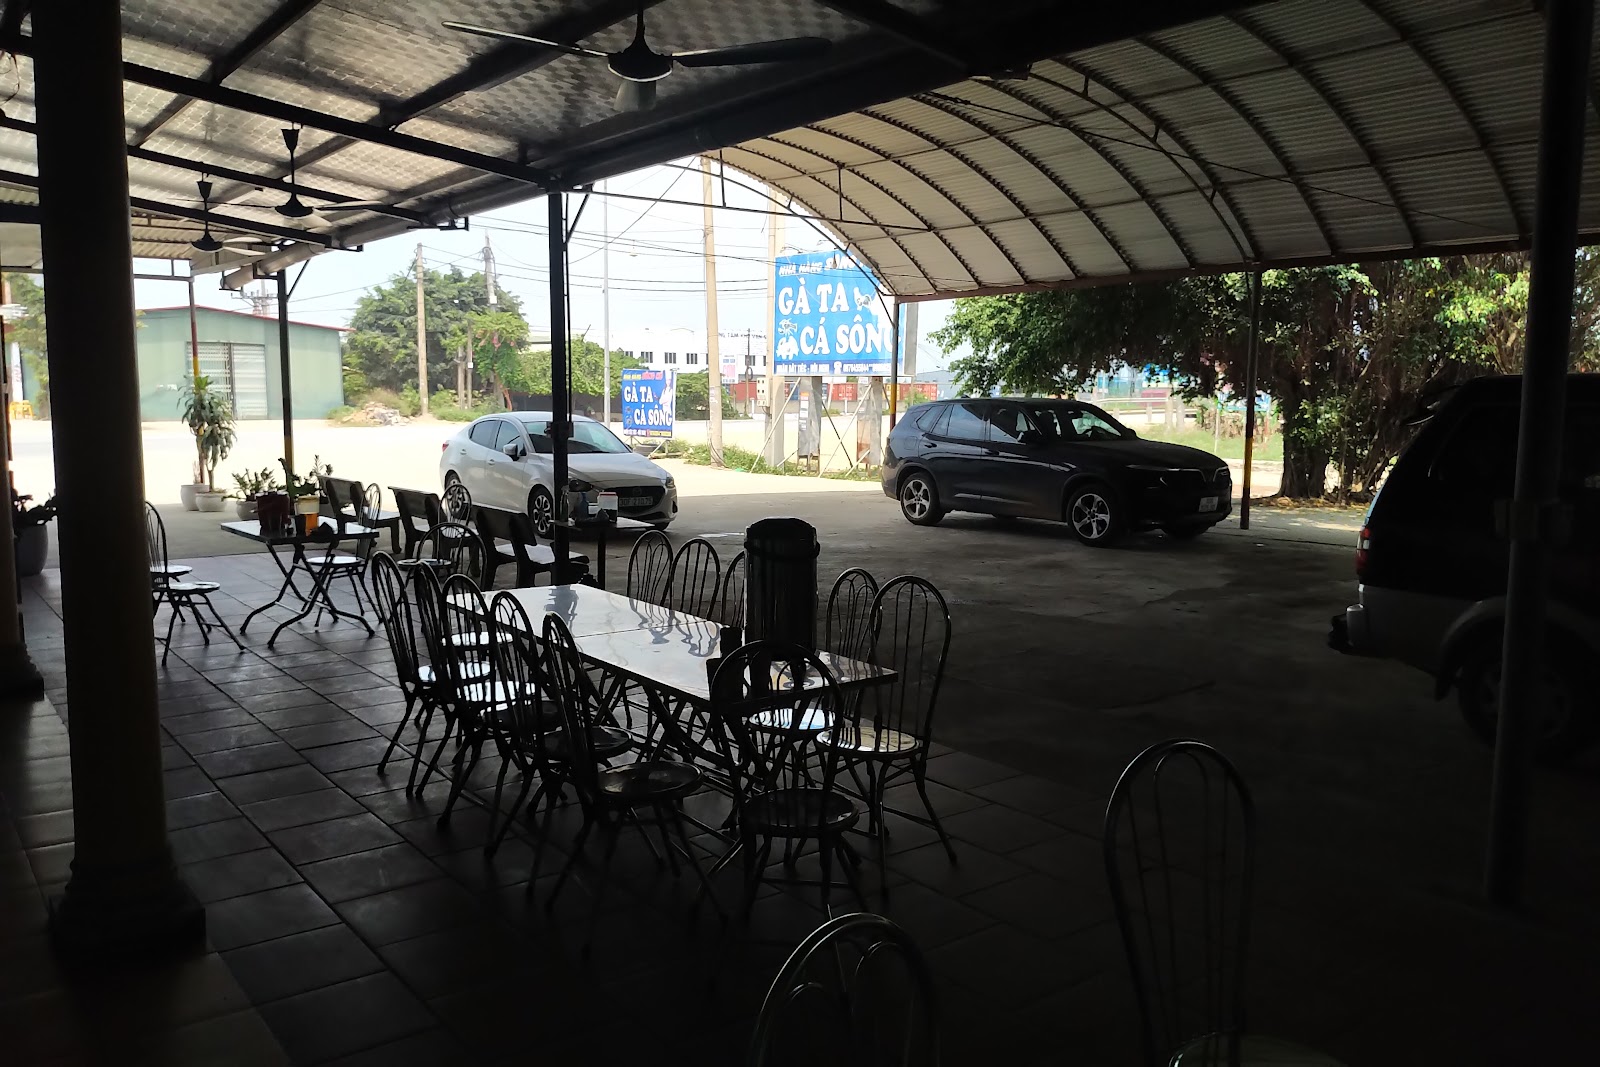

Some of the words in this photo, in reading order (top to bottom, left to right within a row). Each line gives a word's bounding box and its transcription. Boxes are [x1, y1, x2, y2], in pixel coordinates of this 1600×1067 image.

[778, 277, 811, 315] GÀ
[816, 282, 850, 313] TA
[800, 316, 831, 355] CÁ
[624, 381, 639, 403] GÀ
[639, 386, 654, 403] TA
[634, 404, 647, 426] CÁ
[647, 404, 673, 427] SÔNG
